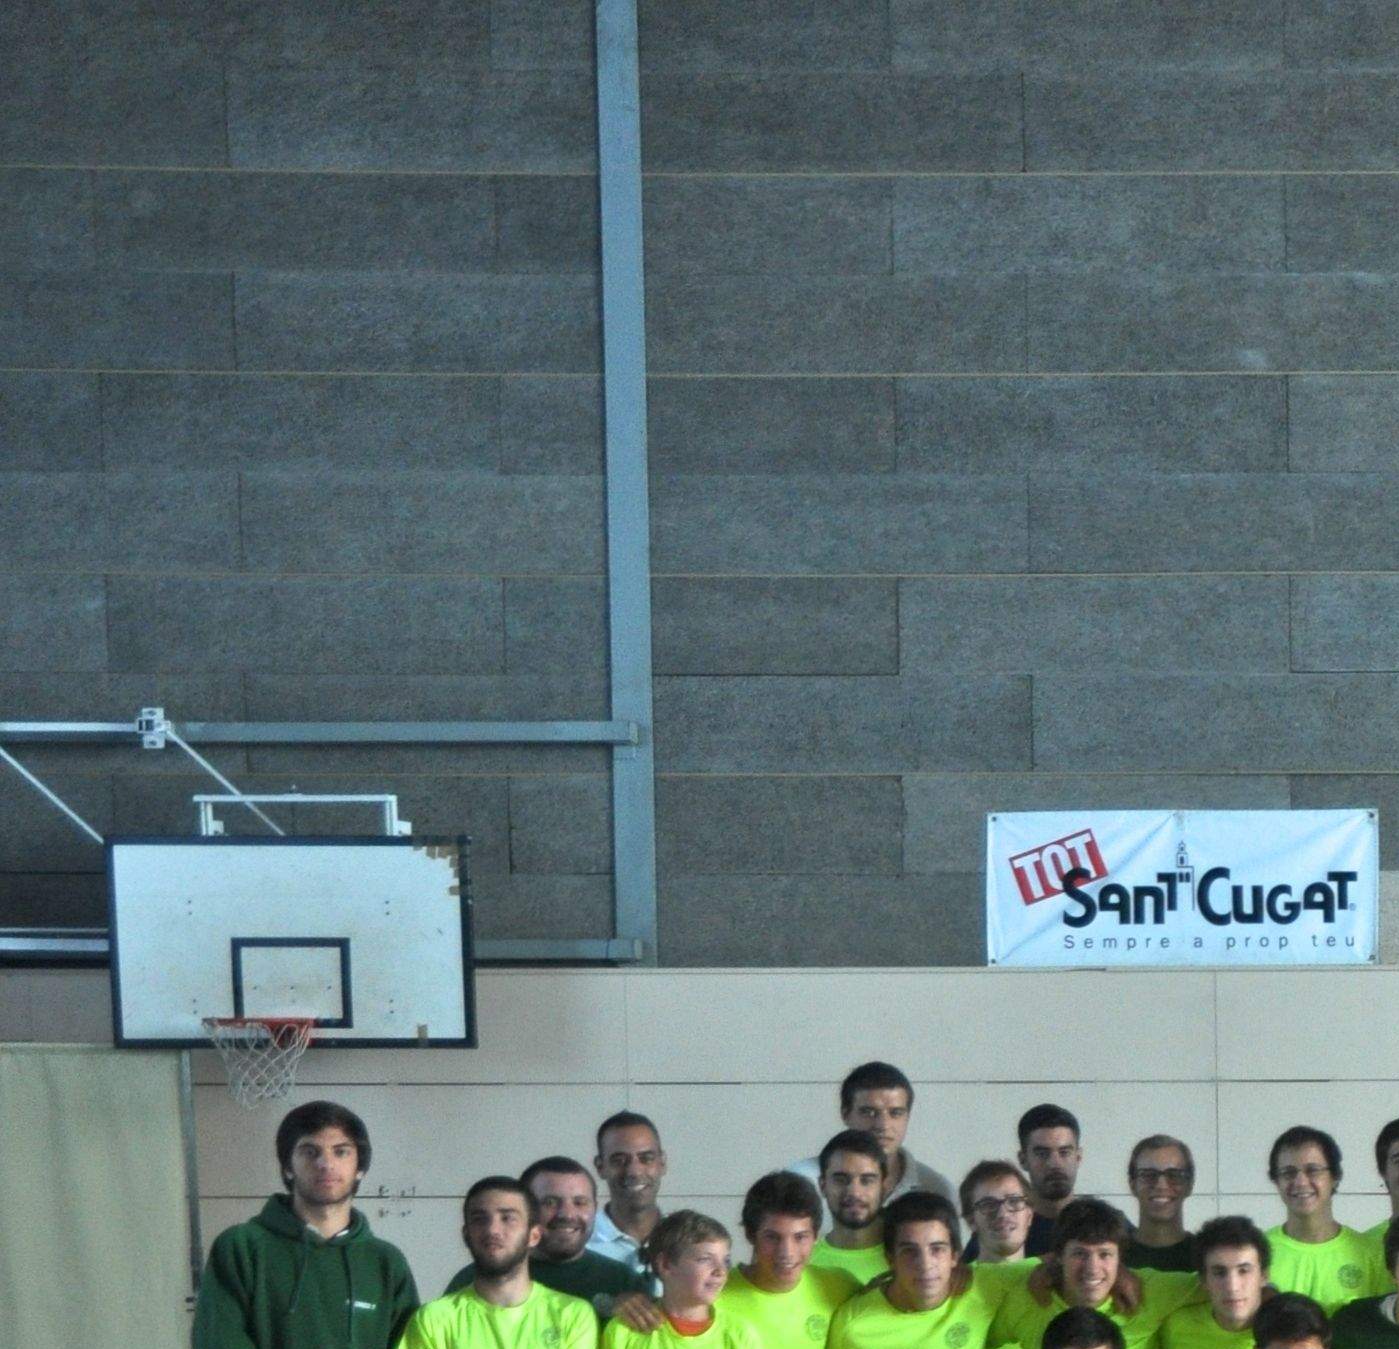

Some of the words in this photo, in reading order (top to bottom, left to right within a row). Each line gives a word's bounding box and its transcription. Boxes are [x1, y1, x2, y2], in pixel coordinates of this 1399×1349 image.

[1012, 832, 1099, 900] TOT
[1063, 934, 1171, 951] Sempre
[1193, 936, 1204, 949] a
[1226, 935, 1289, 950] prop
[1312, 934, 1355, 948] teu
